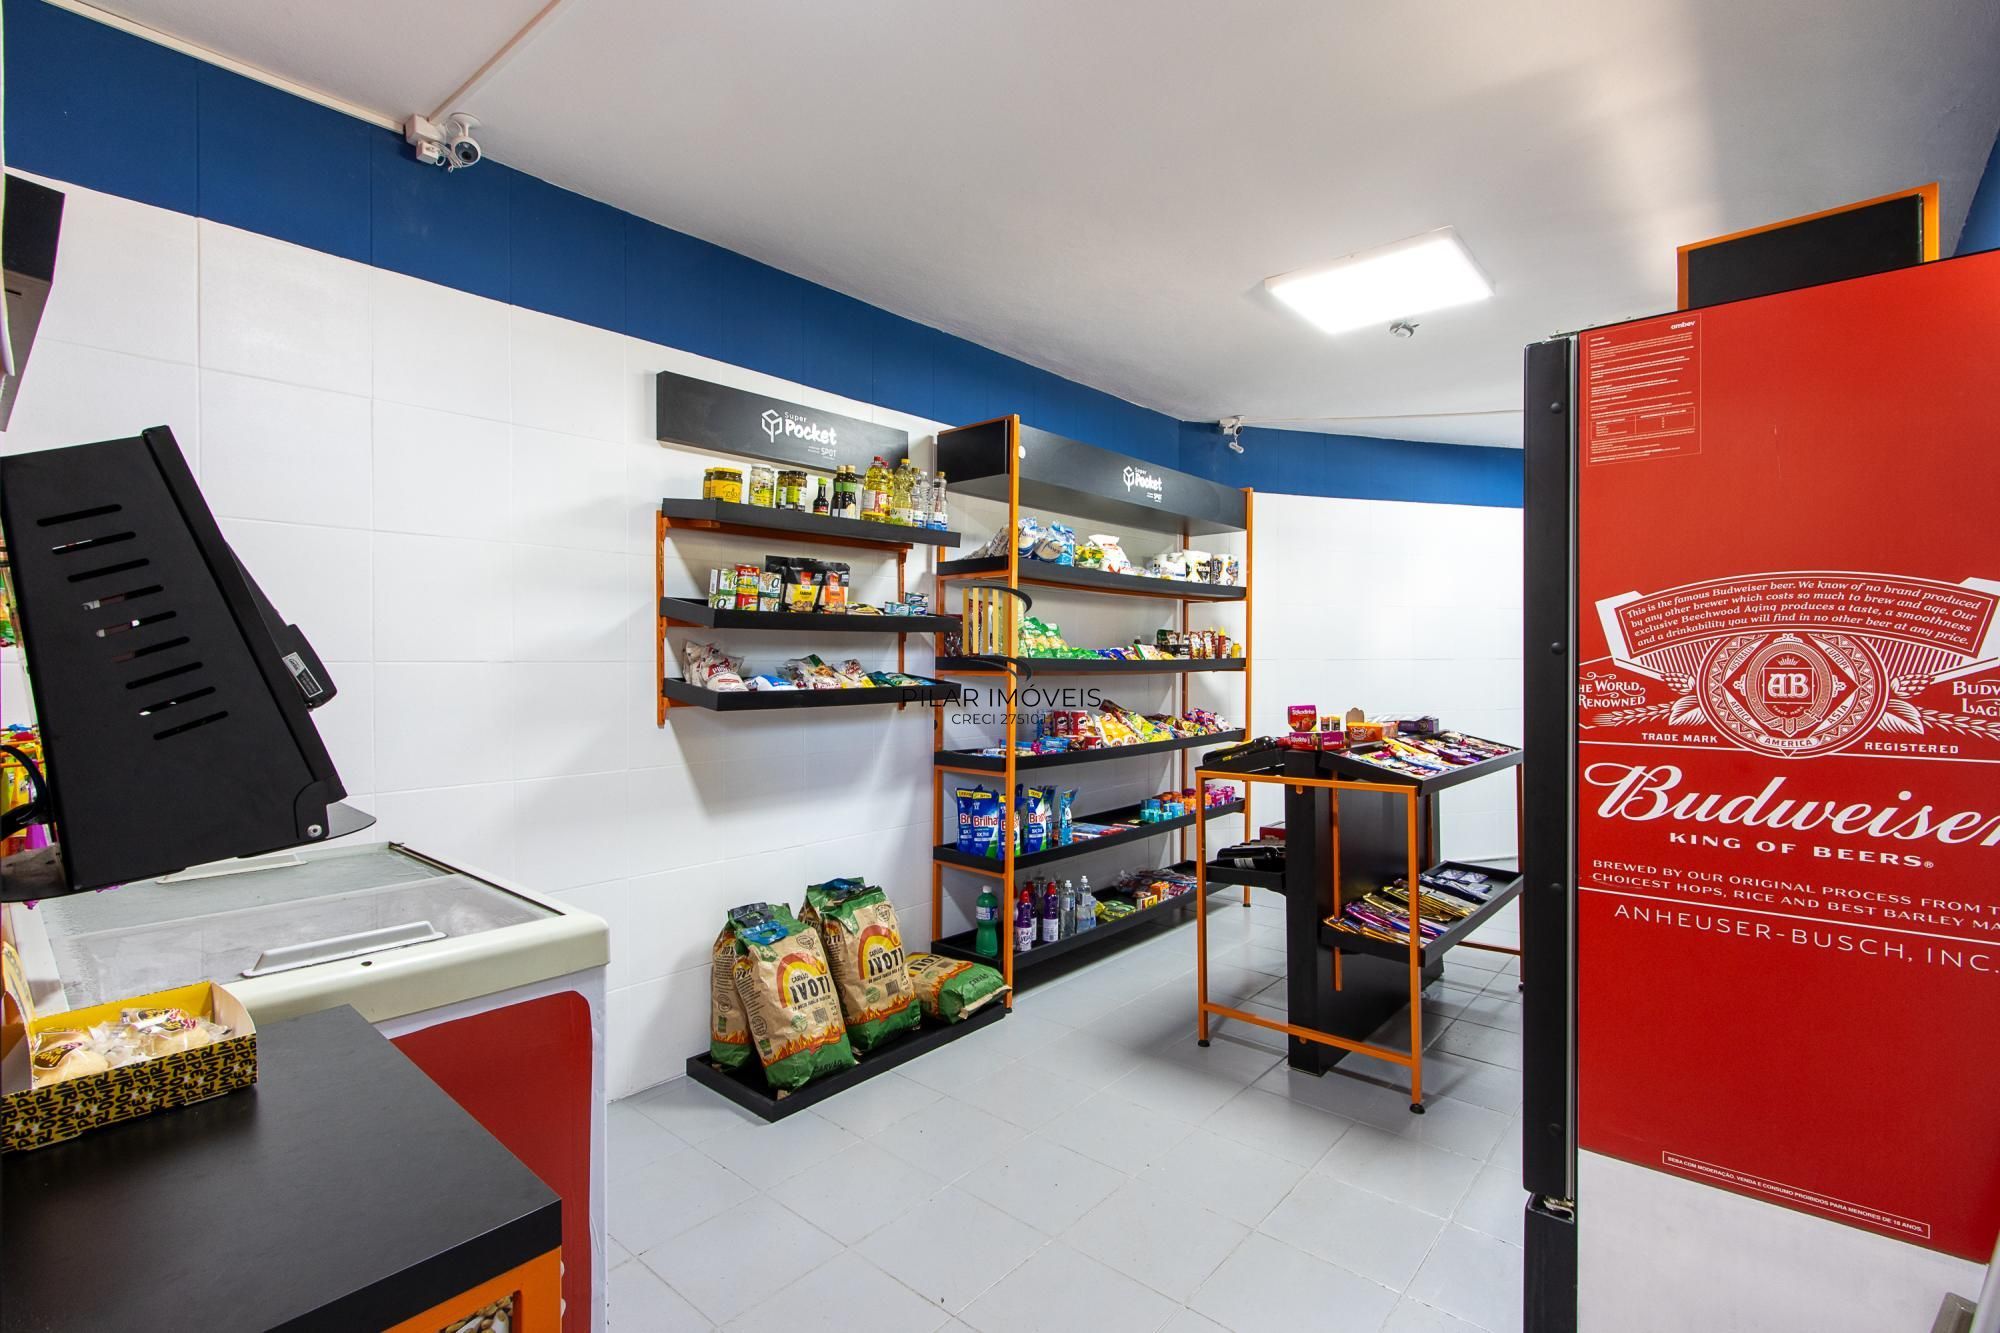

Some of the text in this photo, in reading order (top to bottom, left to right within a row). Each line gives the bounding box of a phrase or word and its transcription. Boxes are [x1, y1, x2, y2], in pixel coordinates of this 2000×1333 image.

[1670, 320, 1696, 330] ambev
[784, 411, 807, 423] Super
[785, 418, 837, 446] Pocket
[821, 447, 837, 457] SPOT
[1135, 472, 1162, 492] Pocket
[1627, 607, 1647, 618] This
[1657, 600, 1673, 608] the
[1674, 592, 1710, 605] famous
[1713, 584, 1768, 596] Budweiser
[1770, 582, 1796, 590] beer.
[1798, 581, 1814, 589] We
[1817, 581, 1849, 589] know
[1851, 582, 1865, 591] of
[1884, 585, 1921, 598] brand
[1922, 592, 1981, 610] produced
[1631, 618, 1643, 628] by
[1645, 613, 1663, 623] any
[1665, 606, 1691, 617] other
[1693, 599, 1728, 610] brewer
[1732, 594, 1762, 604] which
[1766, 592, 1793, 601] costs
[1797, 592, 1810, 600] so
[1813, 591, 1845, 600] much
[1849, 593, 1861, 601] to
[1864, 594, 1896, 605] brew
[1897, 599, 1922, 609] and
[1952, 609, 1977, 621] Our
[1634, 619, 1678, 637] exclusive
[1681, 605, 1740, 623] Beechwood
[1780, 602, 1835, 611] produces
[1848, 604, 1882, 615] taste,
[1895, 610, 1972, 632] smoothness
[1637, 636, 1655, 647] and
[1666, 621, 1726, 638] drinkability
[1728, 617, 1748, 626] you
[1751, 614, 1770, 623] will
[1773, 613, 1795, 623] find
[1798, 613, 1810, 621] in
[1831, 614, 1863, 625] other
[1865, 617, 1892, 628] beer
[1894, 622, 1907, 631] at
[1909, 625, 1933, 637] any
[1935, 631, 1969, 645] price.
[1729, 645, 1755, 672] AUSTRALIA
[1825, 647, 1850, 671] EUROPE
[1767, 673, 1810, 698] AB
[1579, 694, 1645, 709] RENOWNED
[1730, 701, 1752, 723] AFRICA
[1828, 704, 1850, 724] ASIA
[1641, 732, 1718, 743] TRADE MARK
[1764, 738, 1813, 747] AMERICA
[1864, 742, 1959, 754] REGISTERED
[1669, 832, 1742, 850] KING
[1756, 840, 1796, 854] OF
[1593, 859, 1657, 874] BREWED
[1663, 868, 1683, 877] BY
[1687, 871, 1723, 882] OUR
[1729, 875, 1816, 893] ORIGINAL
[1822, 886, 1912, 905] PROCESS
[1921, 898, 1980, 913] FROM
[1592, 872, 1671, 889] CHOICEST
[1676, 882, 1727, 898] HOPS,
[1734, 890, 1775, 903] RICE
[1781, 896, 1820, 908] AND
[1828, 901, 1877, 916] BEST
[1884, 909, 1965, 927] BARLEY
[1614, 904, 2000, 974] ANHEUSER-BUSCH, INC.
[868, 947, 904, 976] IVOTI
[790, 976, 831, 1004] IVOTI
[1667, 1156, 1683, 1165] BEBA
[1736, 1176, 1757, 1185] VENDA
[1762, 1183, 1794, 1196] CONSUMO
[1794, 1191, 1829, 1206] PROIBIDOS
[1830, 1201, 1847, 1211] PARA
[1848, 1206, 1881, 1221] MENORES
[1882, 1216, 1892, 1224] DE
